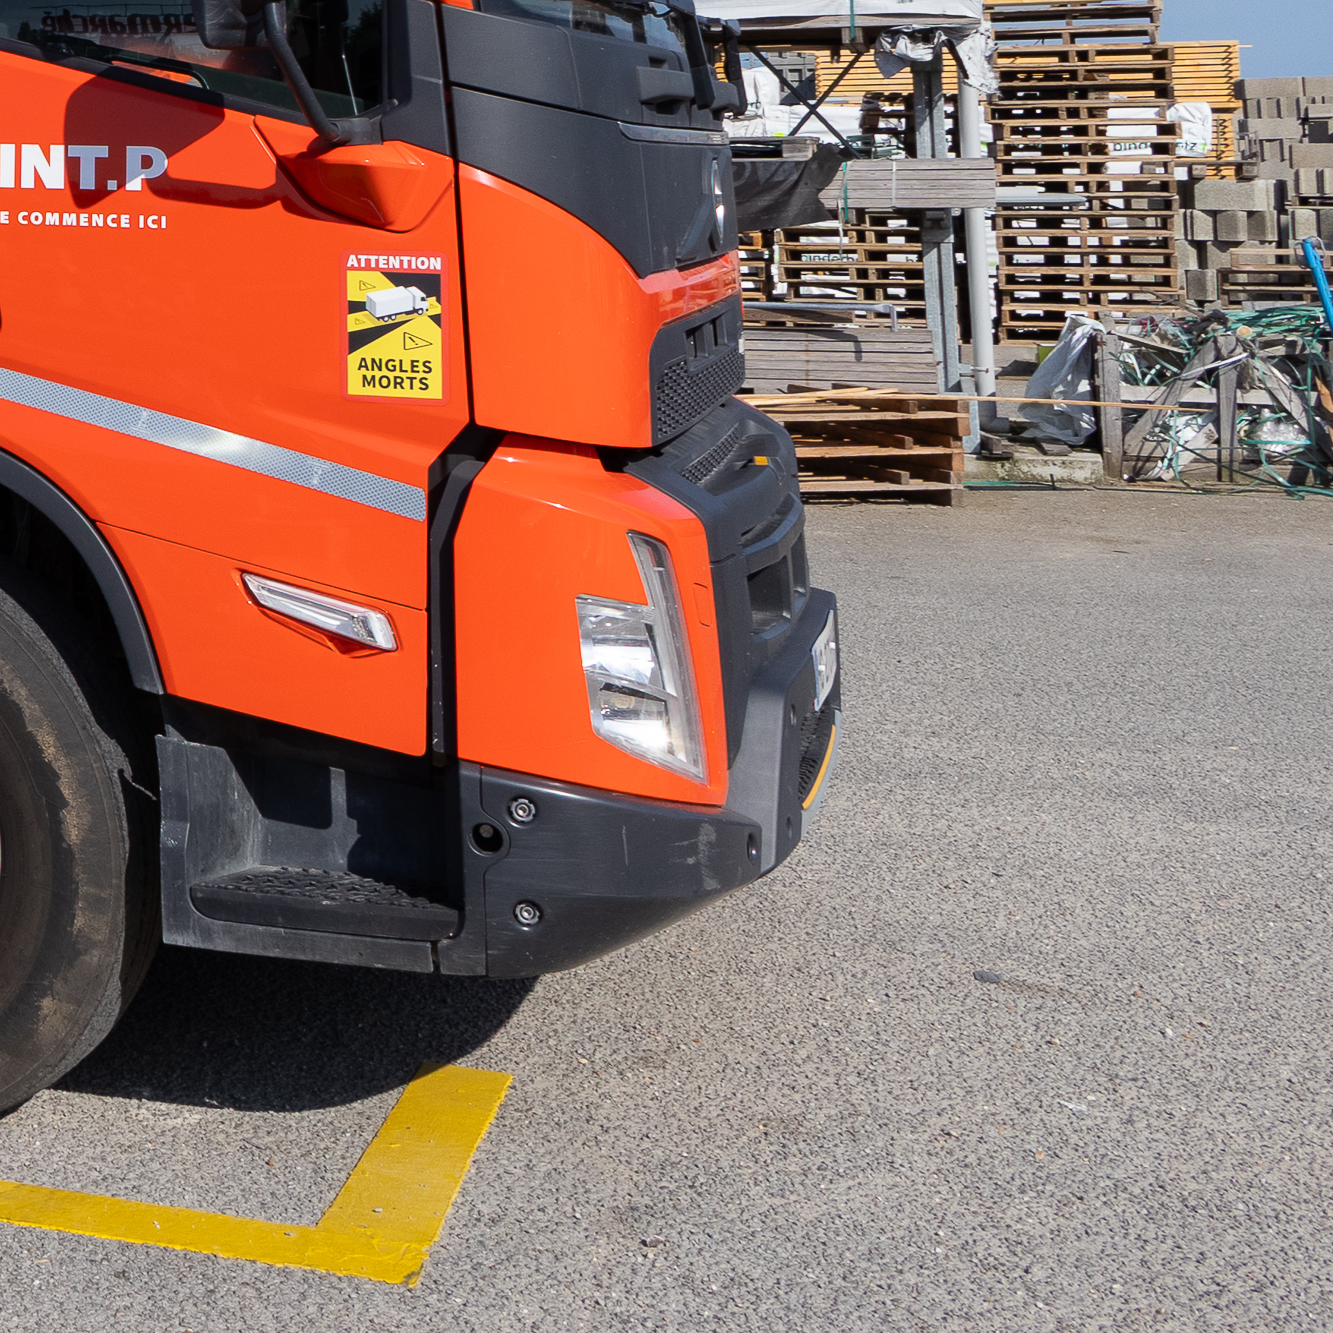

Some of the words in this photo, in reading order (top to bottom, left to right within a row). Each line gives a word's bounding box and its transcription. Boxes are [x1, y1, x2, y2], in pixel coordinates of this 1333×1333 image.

[17, 211, 130, 229] COMMENCE
[138, 215, 167, 229] ICI
[346, 254, 441, 270] ATTENTION
[357, 357, 432, 374] ANGLES
[362, 374, 429, 390] MORTS
